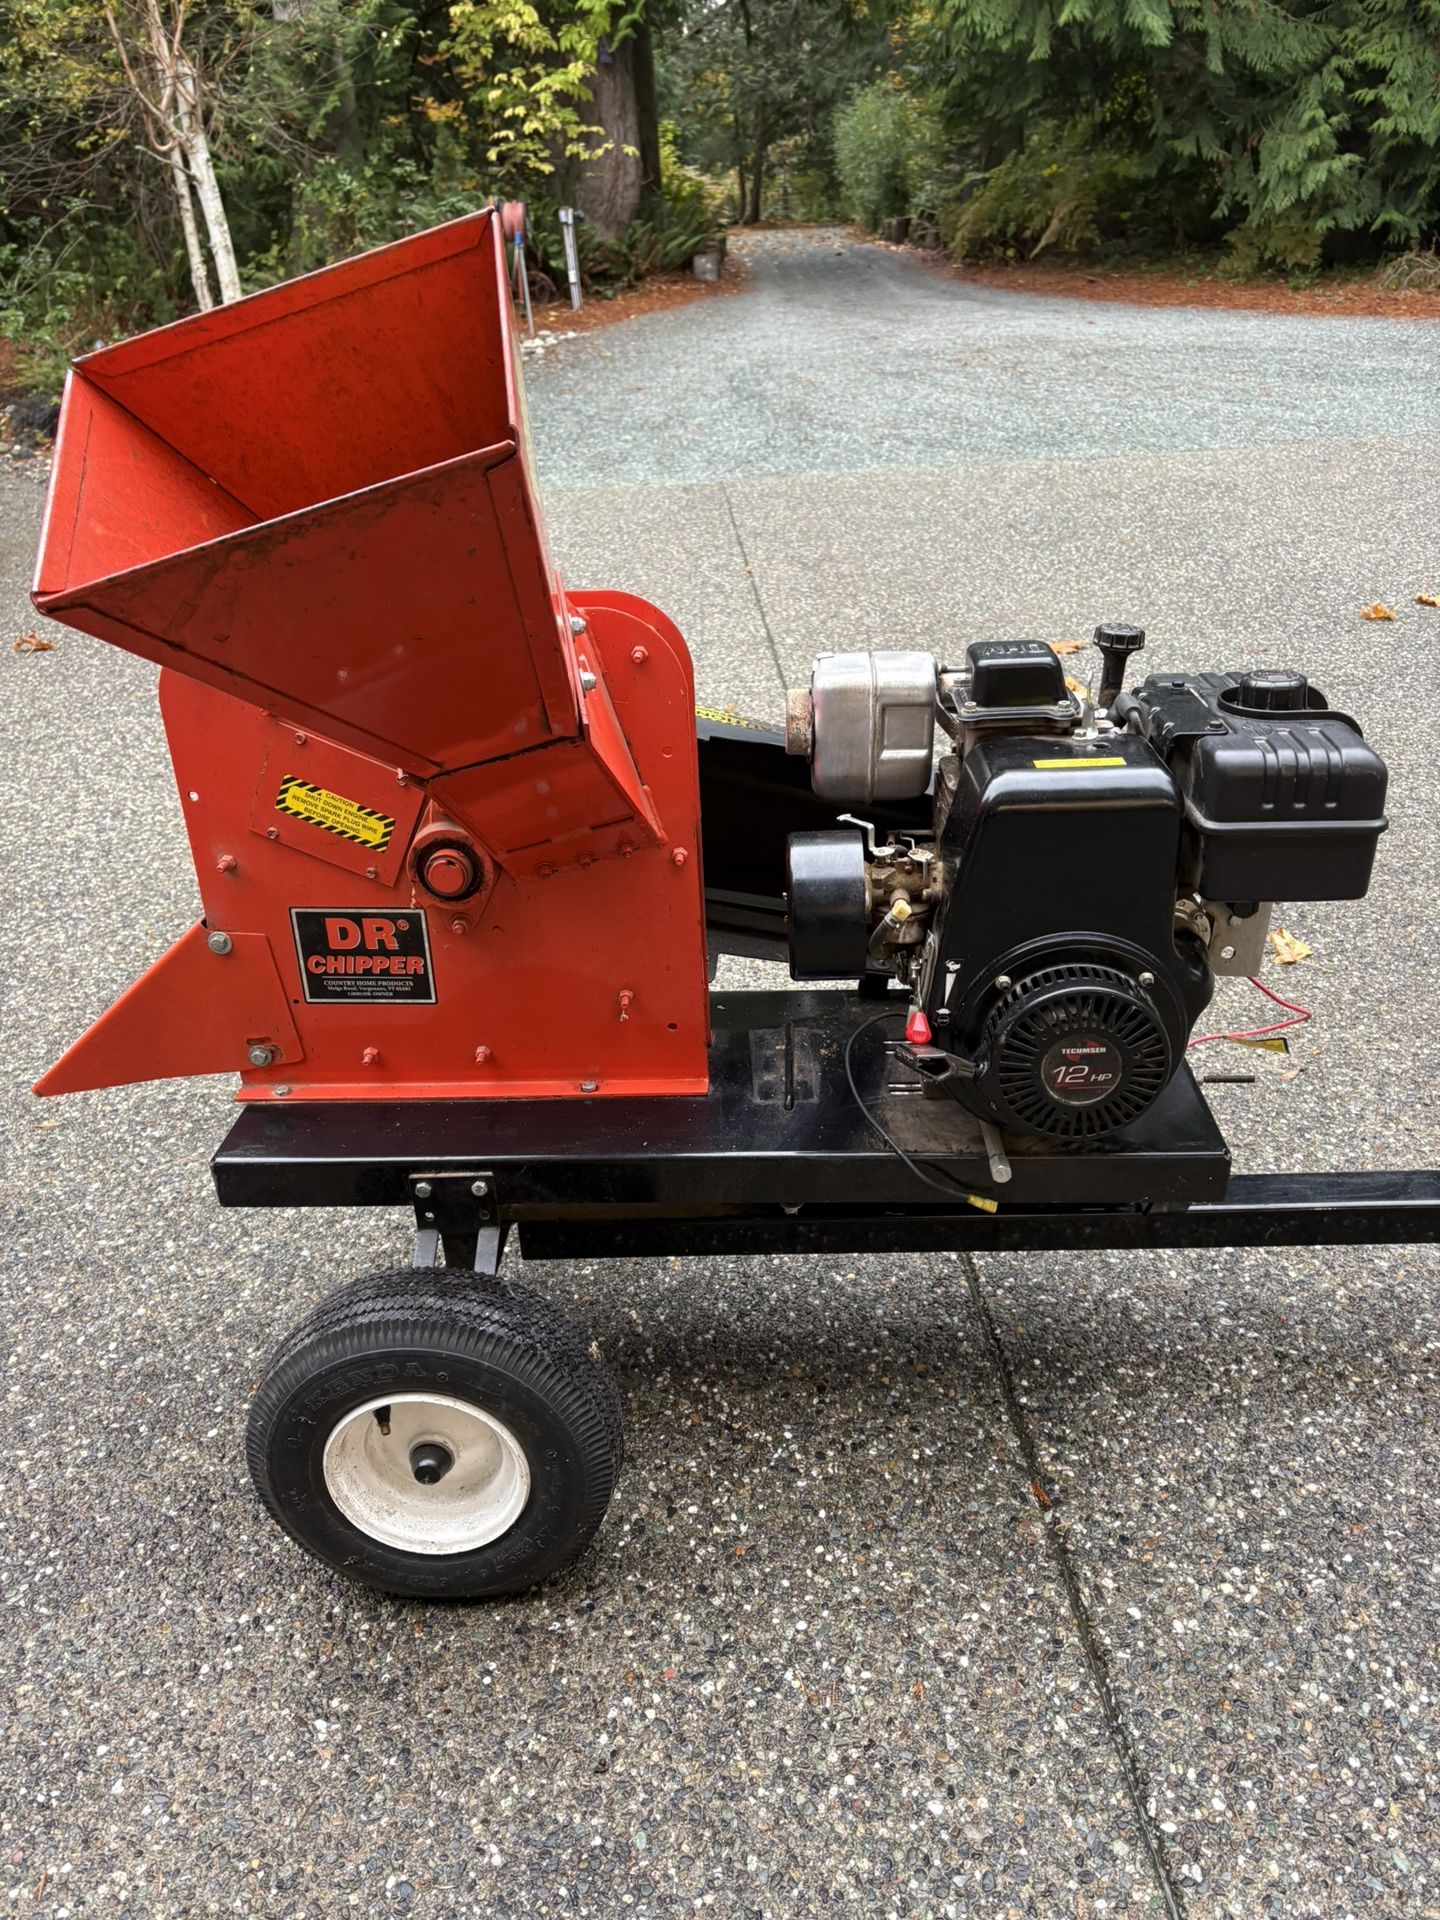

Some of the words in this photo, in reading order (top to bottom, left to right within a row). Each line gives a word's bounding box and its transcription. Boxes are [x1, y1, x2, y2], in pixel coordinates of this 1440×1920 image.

[292, 794, 319, 810] REMOVE
[320, 806, 342, 819] SPARK
[343, 816, 361, 827] PLUG
[362, 823, 378, 834] WIRE
[304, 792, 321, 803] SHUT
[323, 801, 343, 812] DOWN
[344, 809, 369, 822] ENGINE
[326, 793, 354, 808] CAUTION
[304, 807, 329, 821] BEFORE
[331, 819, 360, 834] OPENING
[307, 955, 425, 974] CHIPPER
[1052, 1065, 1089, 1083] 12
[1090, 1073, 1112, 1082] HP
[305, 1362, 427, 1411] KENDA
